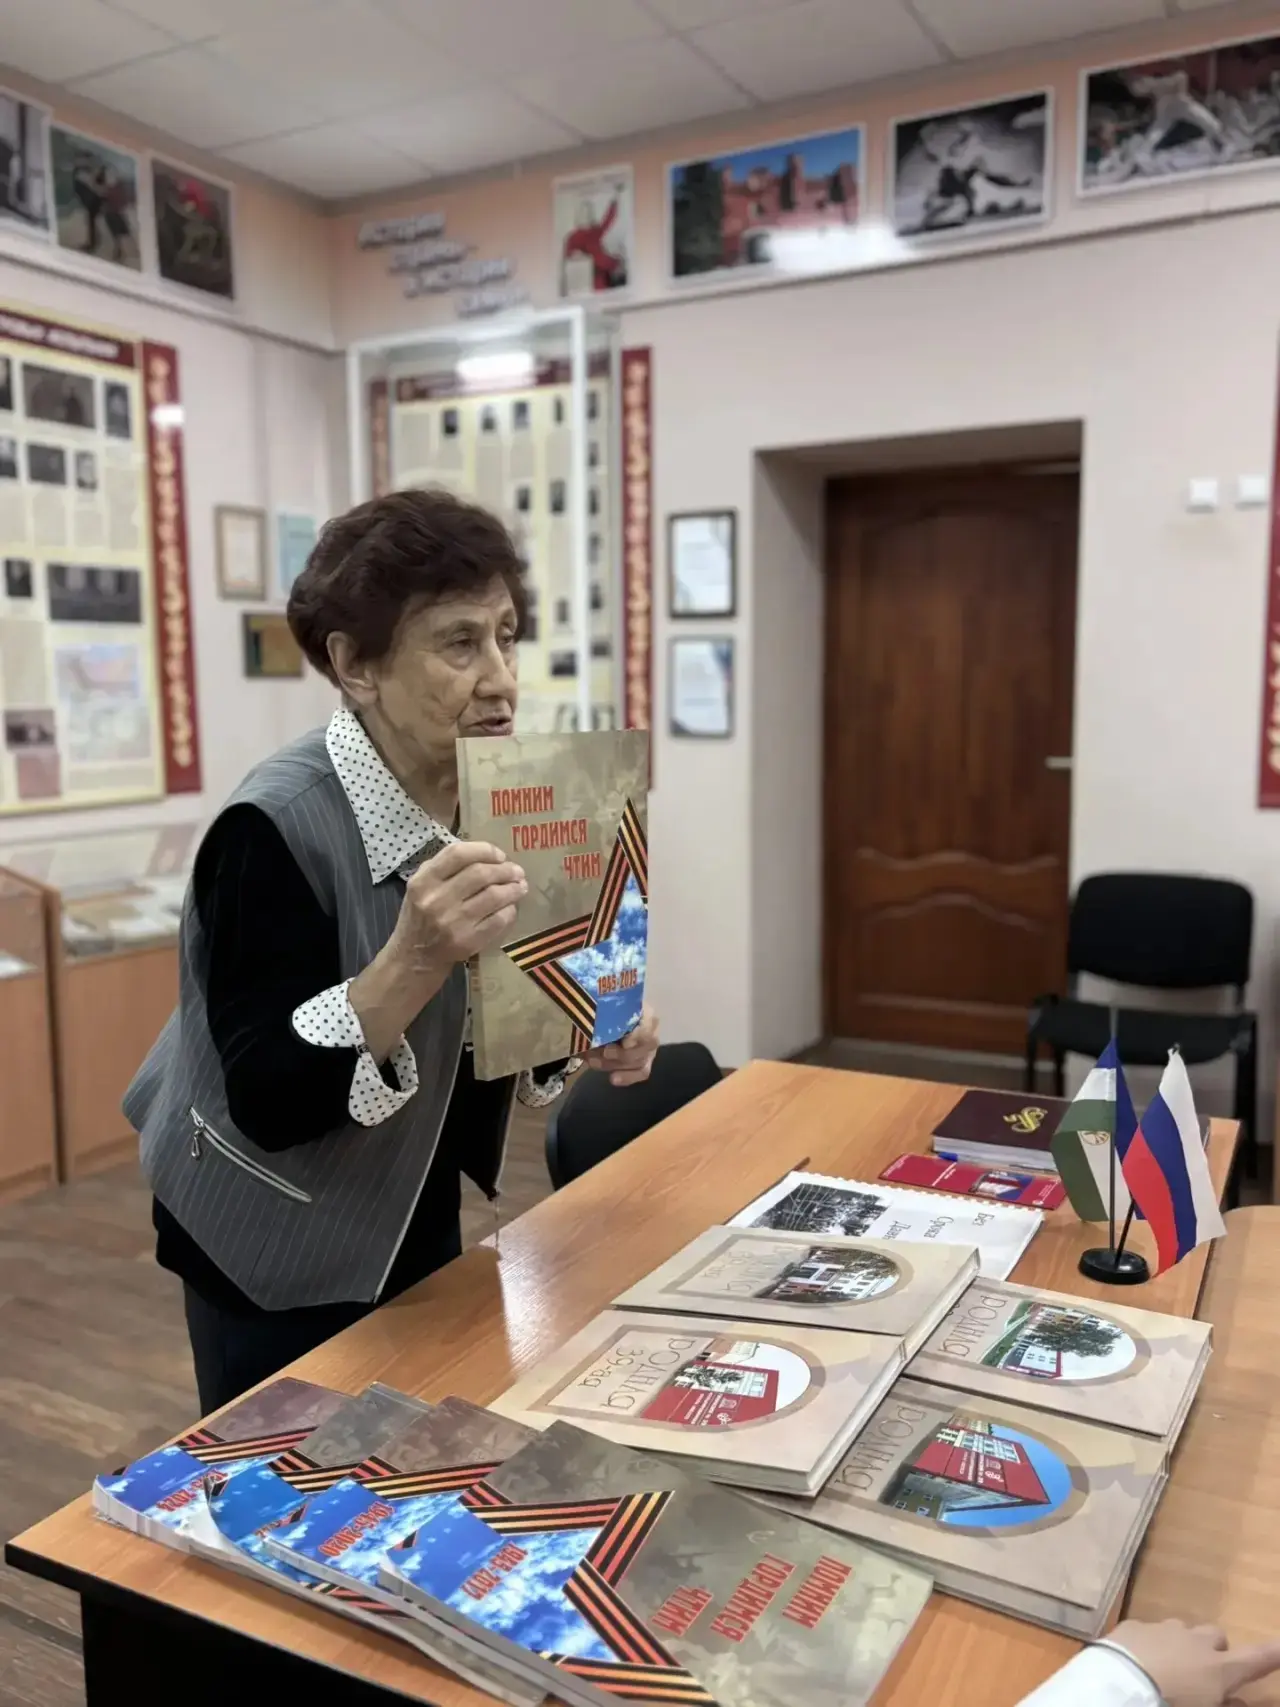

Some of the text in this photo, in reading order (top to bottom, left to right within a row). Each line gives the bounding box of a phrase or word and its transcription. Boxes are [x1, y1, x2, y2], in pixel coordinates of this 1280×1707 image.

[491, 786, 554, 817] ПОМНИМ
[511, 818, 588, 852] ГОРДИМСЯ
[563, 852, 600, 880] ЧТИМ
[597, 967, 638, 996] 1945-2015
[317, 1501, 395, 1557] 1945-2020
[460, 1541, 529, 1601] 1945-2017
[709, 1551, 797, 1643] ГОРДИМСЯ
[782, 1555, 853, 1630] ПОМНИМ
[651, 1584, 714, 1637] ЧТИМ
